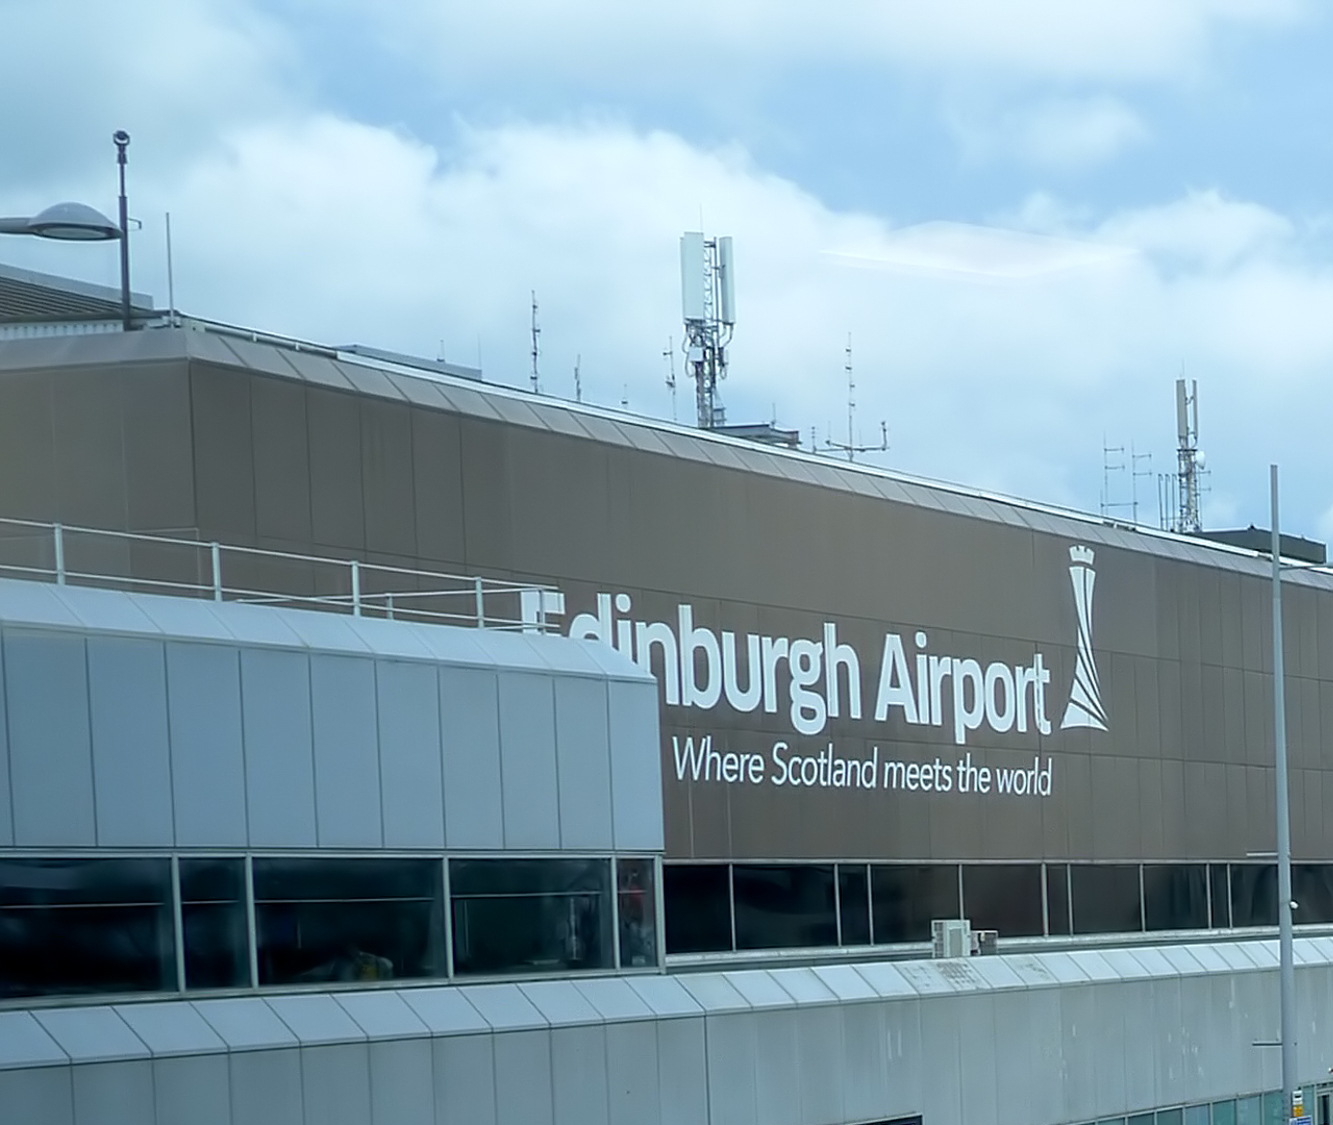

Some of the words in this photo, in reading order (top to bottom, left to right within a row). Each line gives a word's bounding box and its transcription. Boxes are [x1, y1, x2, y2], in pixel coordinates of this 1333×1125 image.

[875, 630, 1053, 744] Airport
[672, 735, 765, 783] Where
[771, 742, 877, 789] Scotland
[883, 760, 952, 792] meets
[957, 751, 989, 794] the
[995, 757, 1052, 796] world
